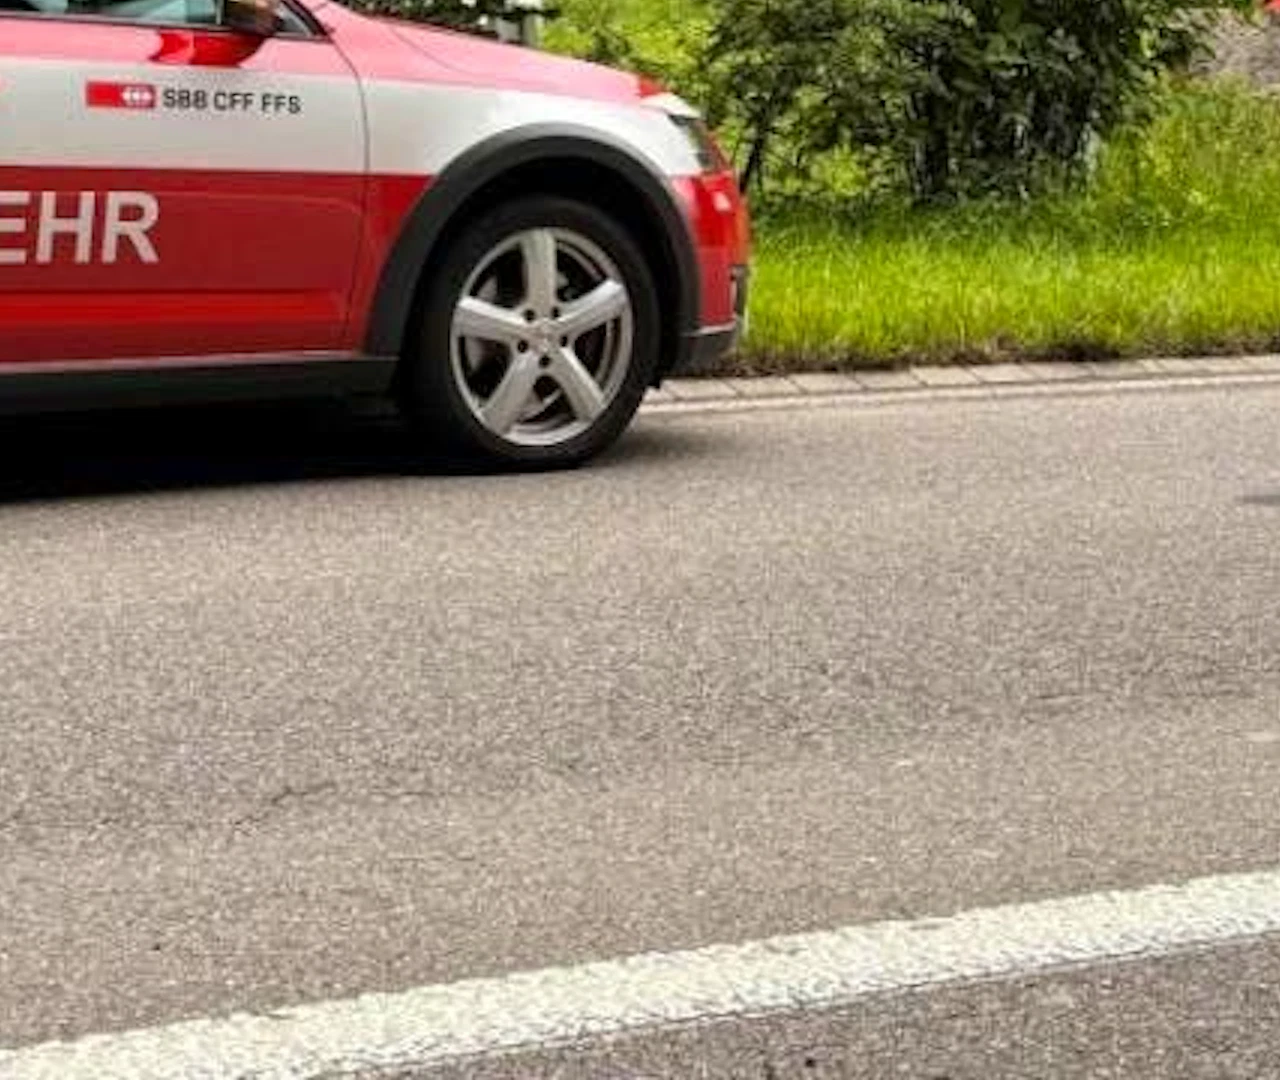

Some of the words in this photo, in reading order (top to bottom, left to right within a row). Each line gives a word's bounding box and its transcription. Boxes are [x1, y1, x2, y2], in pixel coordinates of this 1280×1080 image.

[163, 89, 207, 110] SBB
[213, 92, 254, 111] CFF
[260, 94, 301, 114] FFS
